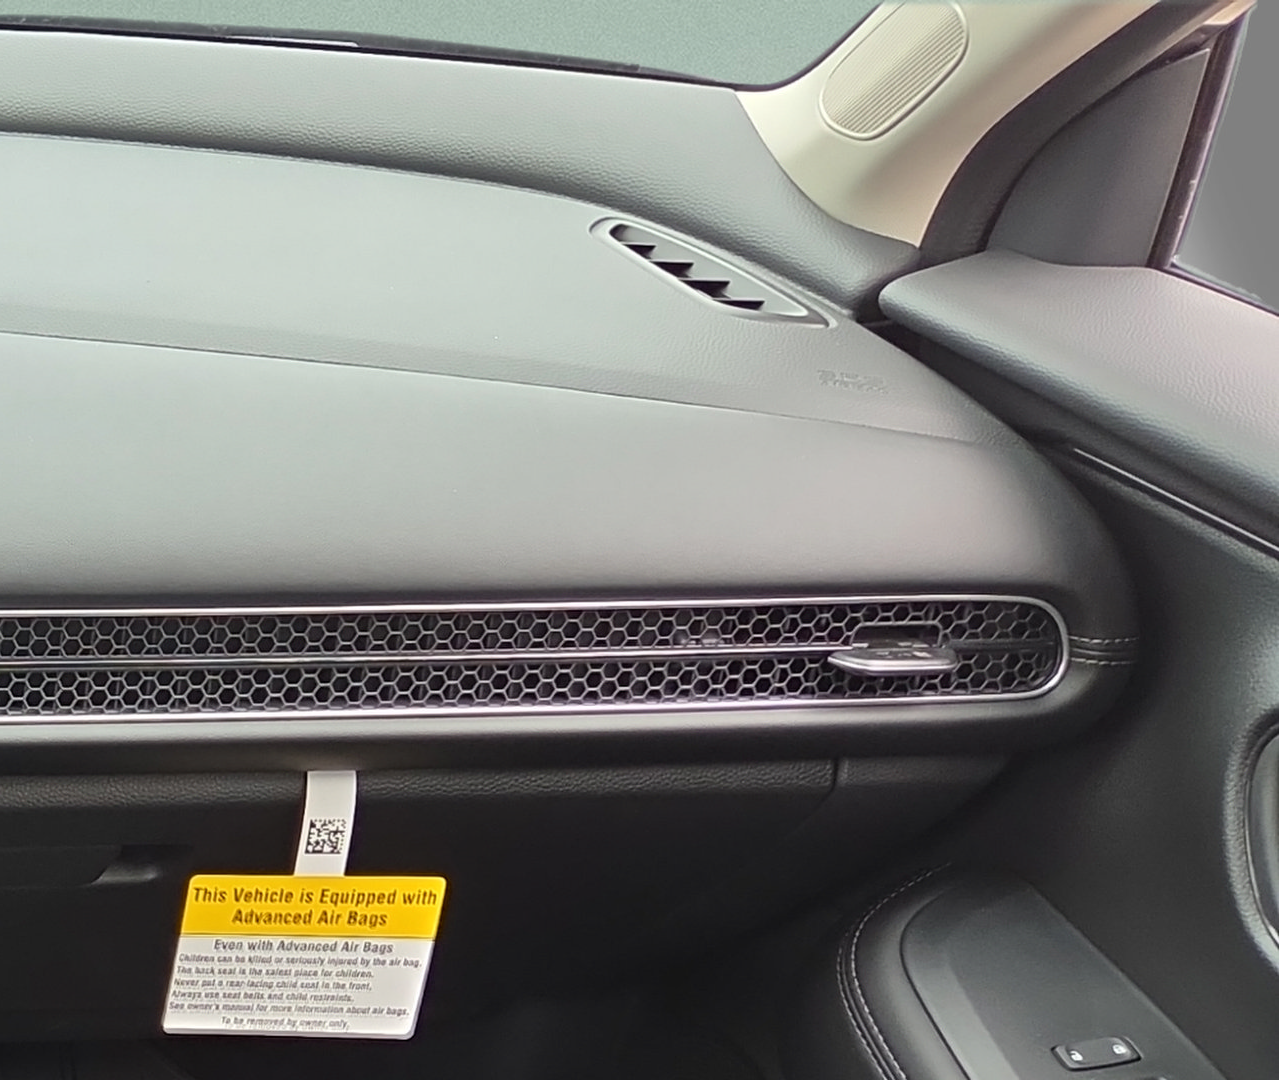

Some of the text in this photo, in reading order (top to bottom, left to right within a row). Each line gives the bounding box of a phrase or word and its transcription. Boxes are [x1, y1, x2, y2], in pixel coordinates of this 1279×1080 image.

[194, 887, 437, 908] This Vehicle is Equipped with
[231, 908, 388, 928] Advanced Air Bags
[213, 939, 394, 955] Even with Advanced Air Bags
[179, 953, 215, 963] Children
[217, 955, 232, 963] can
[234, 955, 246, 963] be
[248, 955, 273, 964] killed
[285, 956, 325, 966] seriously
[327, 957, 359, 966] injured
[360, 958, 371, 967] by
[373, 958, 387, 966] the
[388, 958, 401, 966] air
[403, 958, 422, 968] bag.
[177, 966, 192, 974] The
[194, 966, 215, 975] back
[218, 967, 236, 975] seat
[249, 967, 263, 975] the
[265, 967, 292, 976] safest
[293, 968, 319, 977] place
[321, 969, 332, 977] for
[335, 969, 374, 978] children.
[174, 978, 199, 987] Never
[201, 979, 216, 988] put
[276, 980, 298, 988] child
[300, 981, 319, 989] seat
[332, 981, 346, 989] the
[171, 990, 202, 1000] Always
[204, 991, 220, 999] use
[222, 991, 241, 999] seat
[243, 991, 264, 999] belts
[267, 992, 283, 1000] and
[285, 993, 308, 1001] child
[169, 1001, 185, 1010] See
[222, 1003, 254, 1011] manual
[256, 1004, 268, 1012] for
[294, 1005, 344, 1013] information
[346, 1006, 370, 1014] about
[372, 1007, 385, 1015] air
[386, 1007, 410, 1017] bags.
[222, 1016, 231, 1024] To
[246, 1017, 285, 1025] removed
[287, 1018, 297, 1027] by
